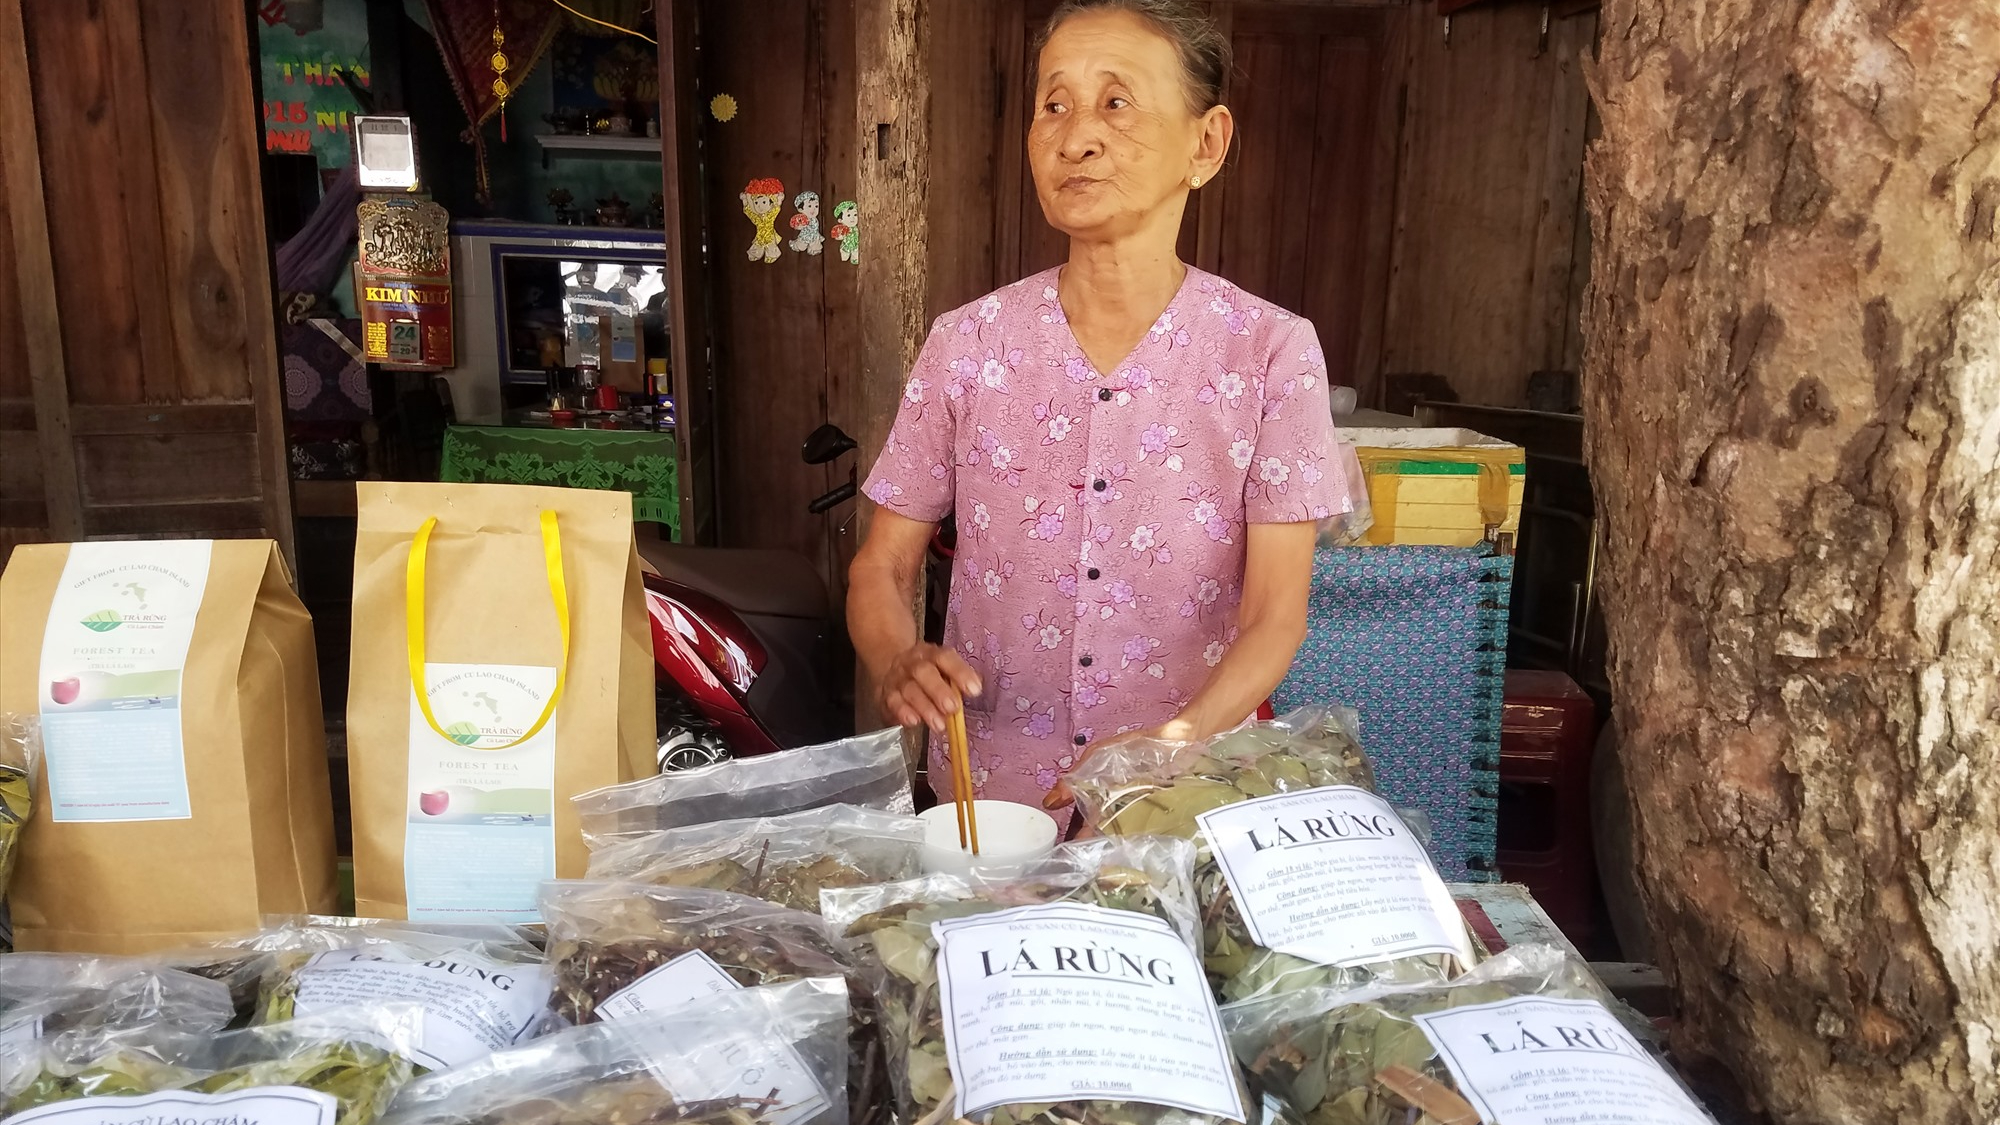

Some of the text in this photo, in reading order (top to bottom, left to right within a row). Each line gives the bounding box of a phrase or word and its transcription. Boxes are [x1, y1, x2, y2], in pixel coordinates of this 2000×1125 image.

[365, 287, 403, 303] KIM
[394, 325, 417, 341] 24
[93, 567, 115, 580] FROM
[168, 570, 191, 589] ISLAND
[73, 646, 156, 656] FOREST TEA
[442, 674, 461, 687] FROM
[516, 680, 540, 701] ISLAND
[480, 727, 498, 735] TRÀ
[439, 760, 519, 771] FOREST TEA
[1245, 809, 1396, 853] LÁ RỪNG
[980, 938, 1176, 987] LÁ RỪNG
[423, 959, 516, 991] DUNG
[1479, 1020, 1656, 1066] LÁ RỪN
